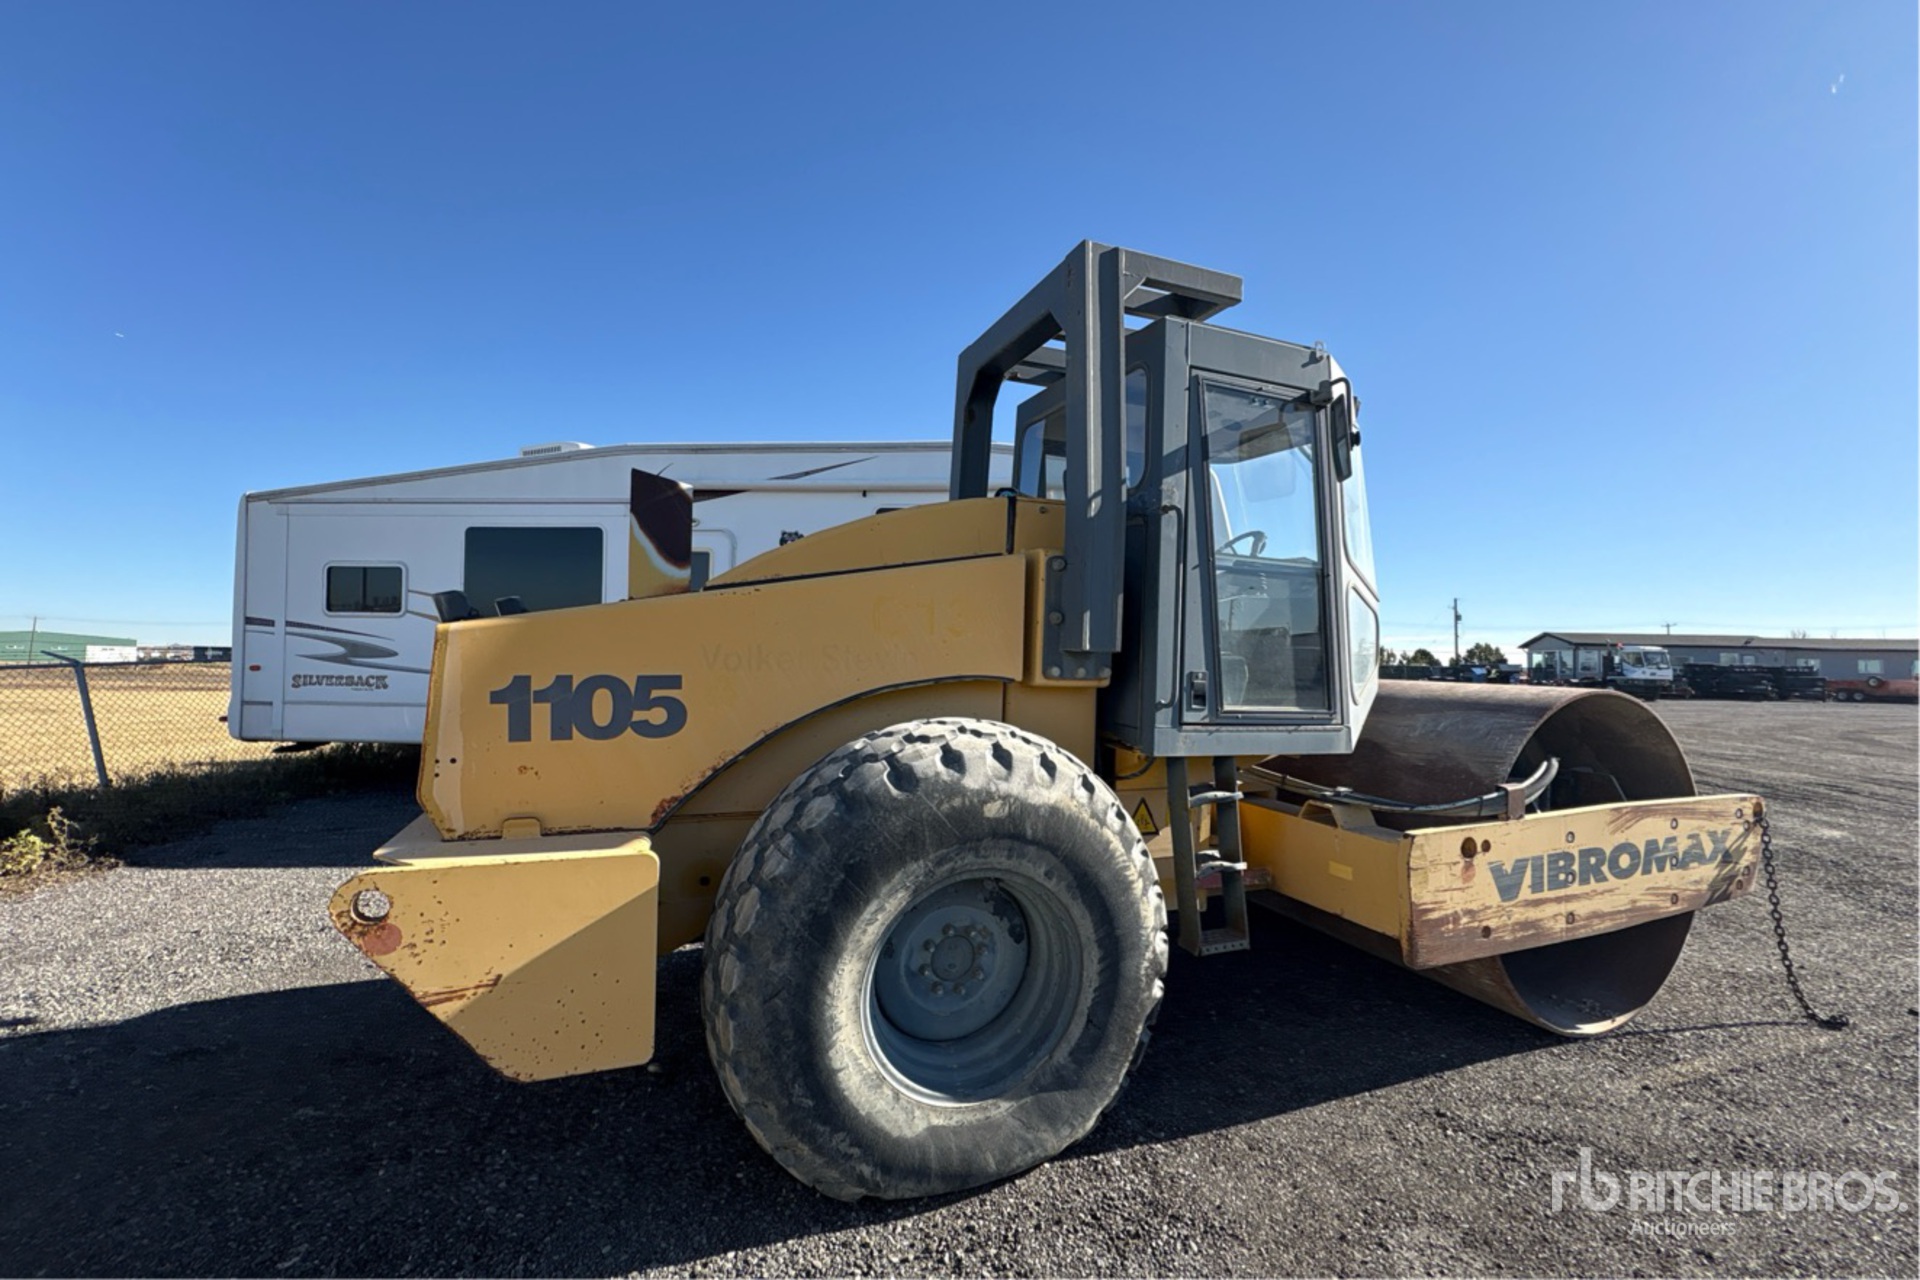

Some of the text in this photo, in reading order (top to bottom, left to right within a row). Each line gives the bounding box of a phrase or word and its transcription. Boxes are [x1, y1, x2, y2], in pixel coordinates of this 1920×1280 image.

[291, 674, 389, 690] SILVERBACK
[490, 674, 688, 742] 1105
[1488, 829, 1734, 903] VIBROMAX
